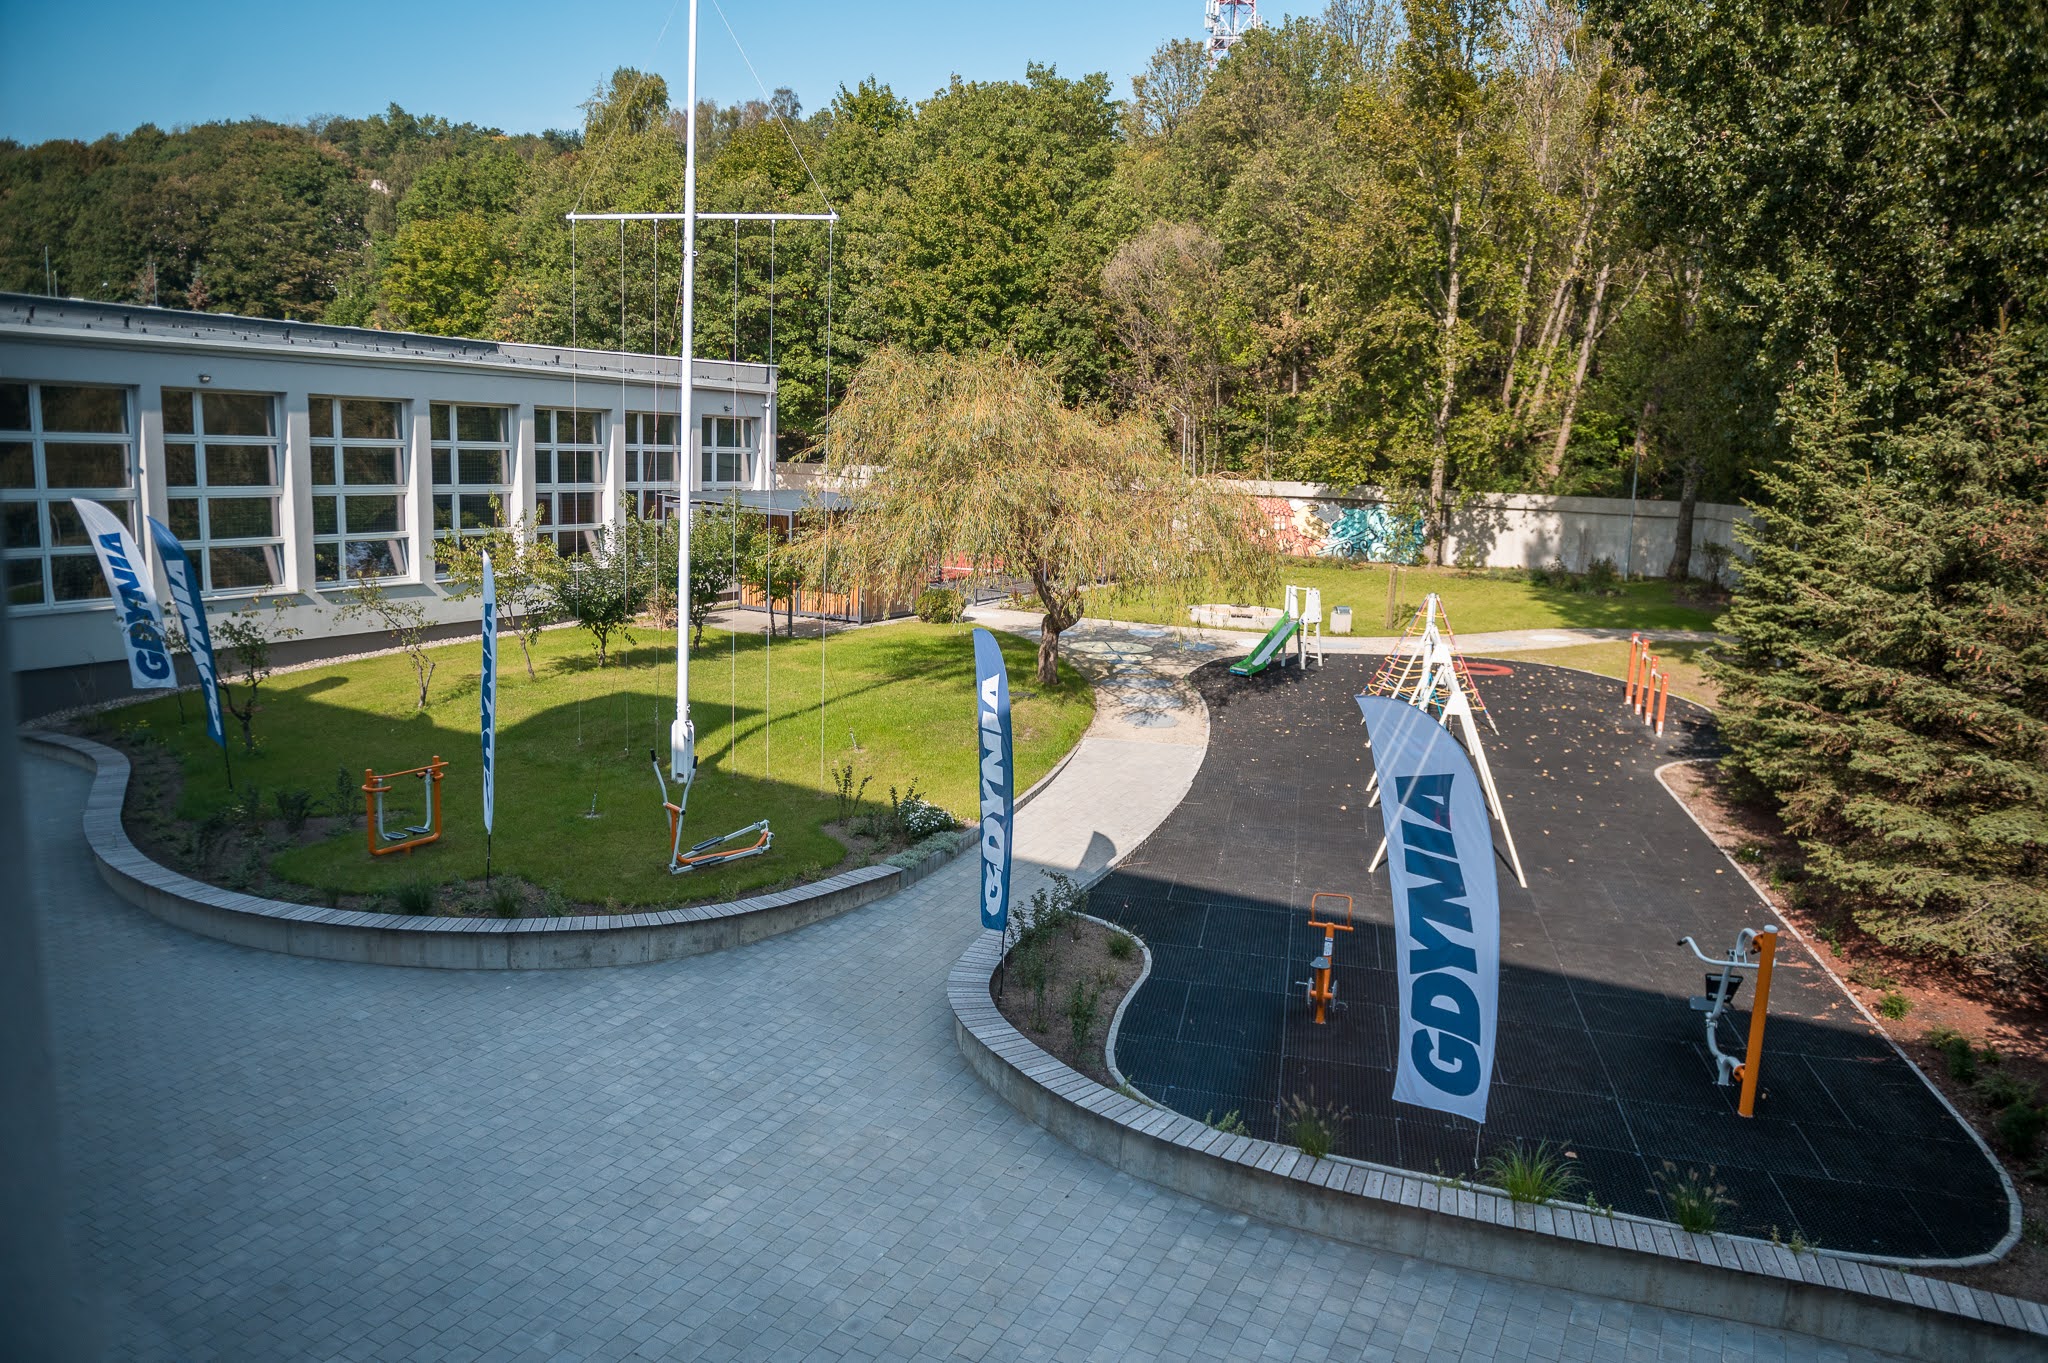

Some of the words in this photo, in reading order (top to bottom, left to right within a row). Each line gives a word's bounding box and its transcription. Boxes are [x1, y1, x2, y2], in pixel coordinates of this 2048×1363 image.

[98, 532, 170, 680] GDYNIA
[981, 673, 1005, 917] GDYNIA
[1395, 773, 1482, 1097] GDYNIA
